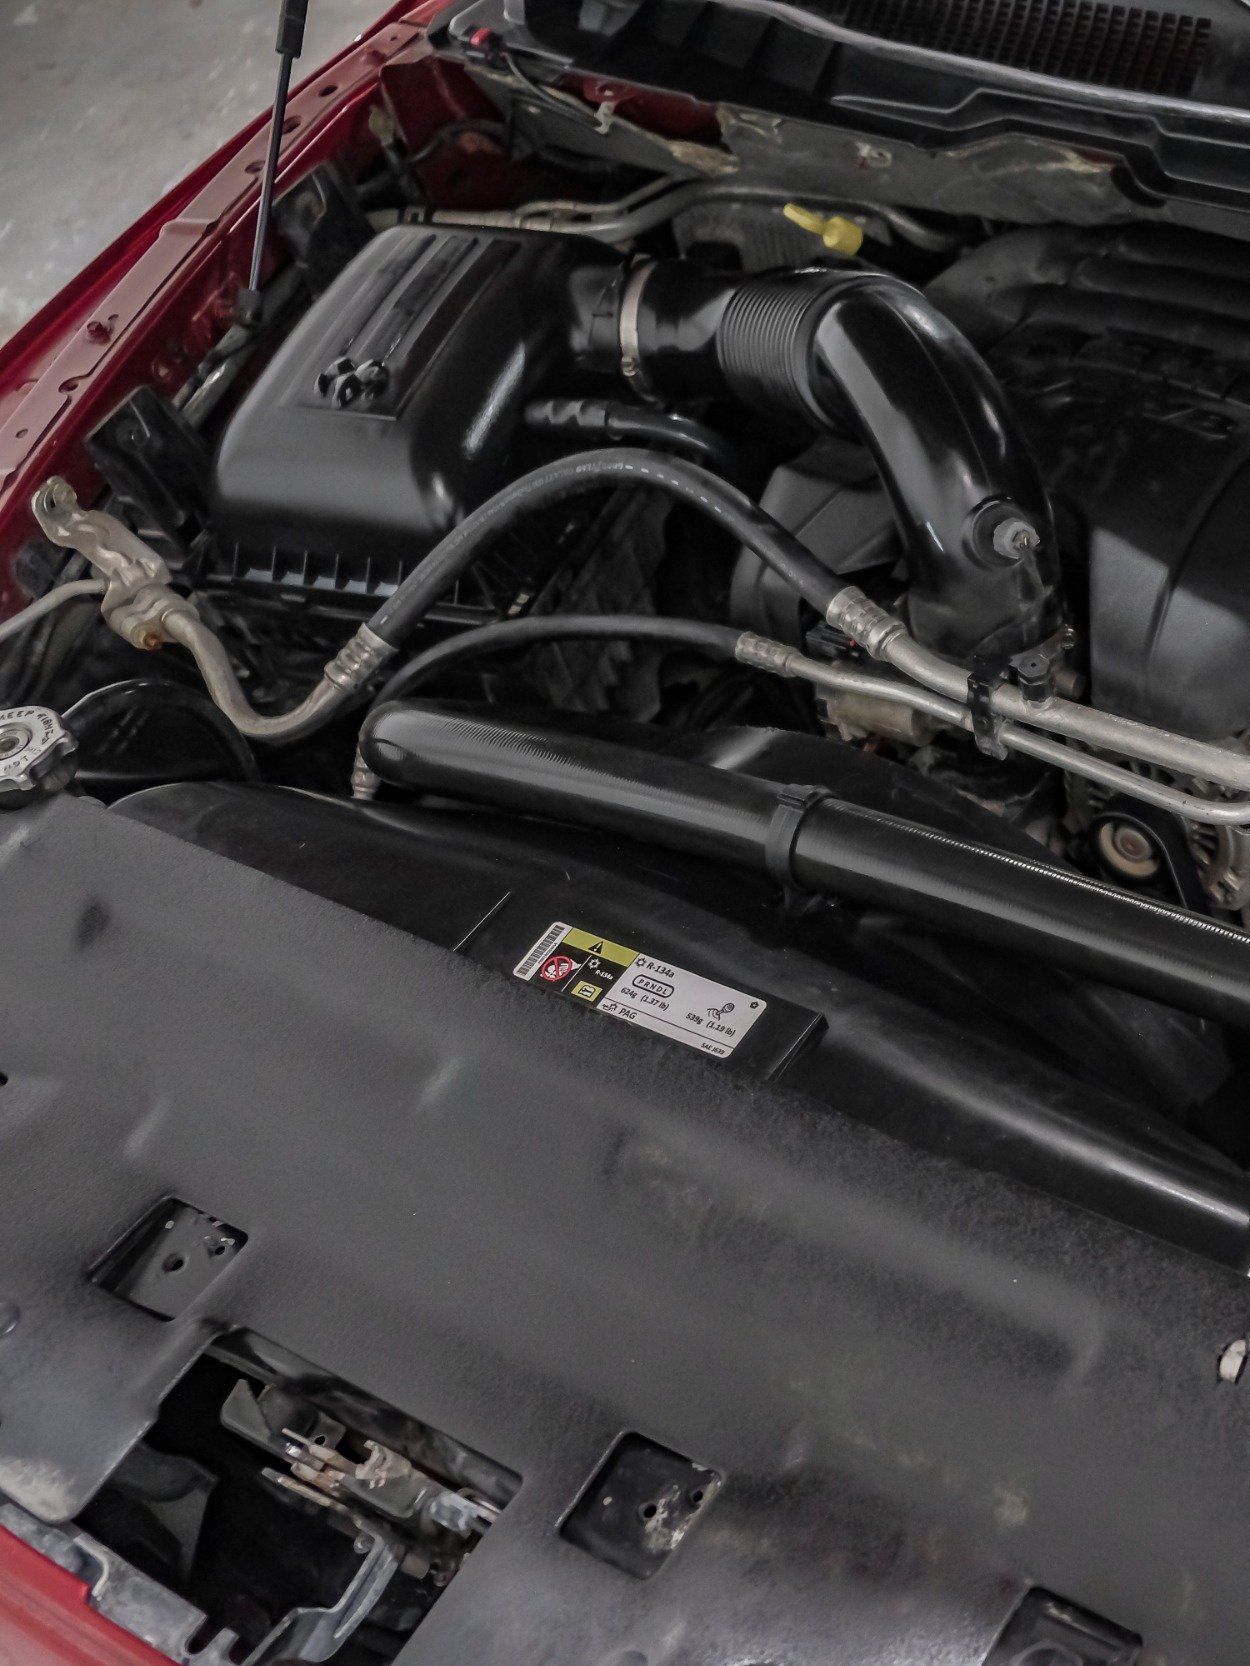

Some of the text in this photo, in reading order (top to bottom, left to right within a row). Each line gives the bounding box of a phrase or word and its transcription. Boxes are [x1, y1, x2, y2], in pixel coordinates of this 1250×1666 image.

[646, 962, 675, 978] R-134a
[621, 987, 638, 999] 624g
[640, 994, 659, 1006] (1.37
[618, 1007, 637, 1020] PAG
[686, 1012, 703, 1025] 539g
